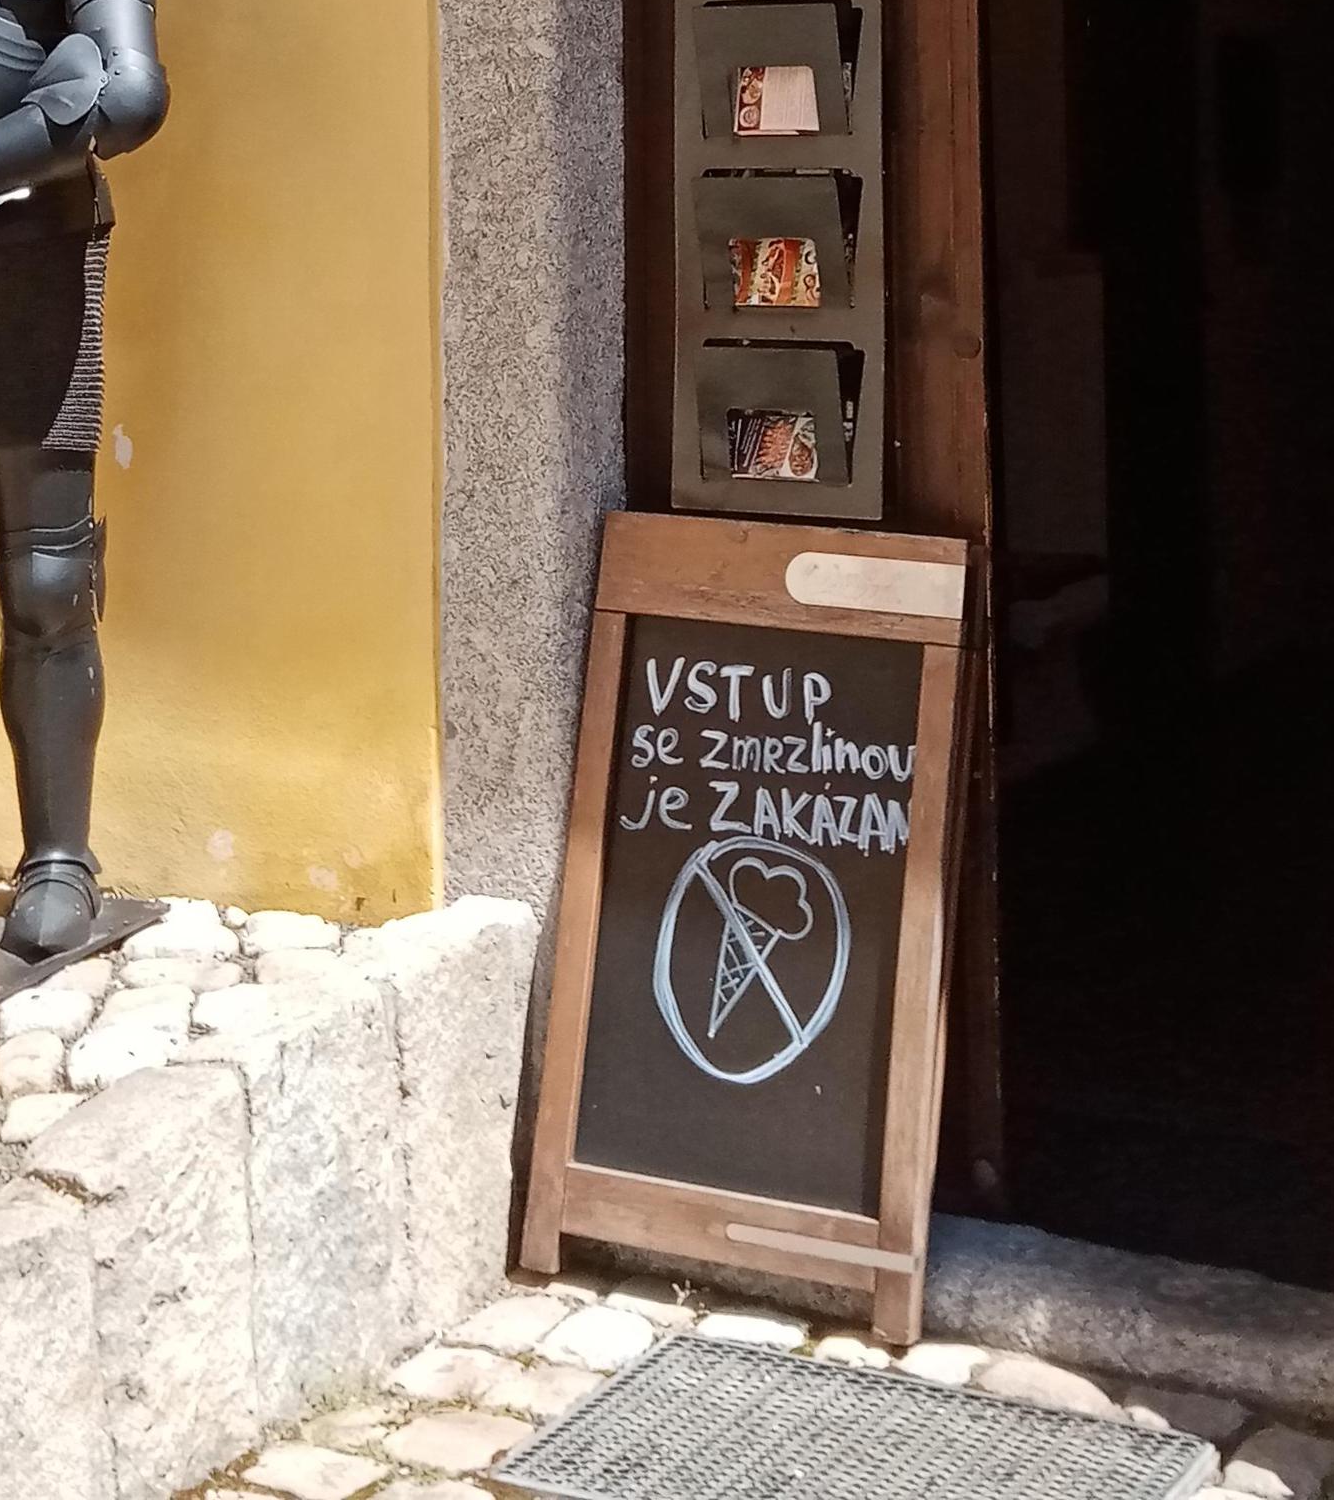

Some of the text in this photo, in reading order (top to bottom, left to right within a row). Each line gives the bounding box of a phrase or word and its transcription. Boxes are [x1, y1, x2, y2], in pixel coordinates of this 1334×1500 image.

[646, 657, 833, 725] VSTUP
[631, 724, 685, 768] se
[619, 775, 693, 831] je
